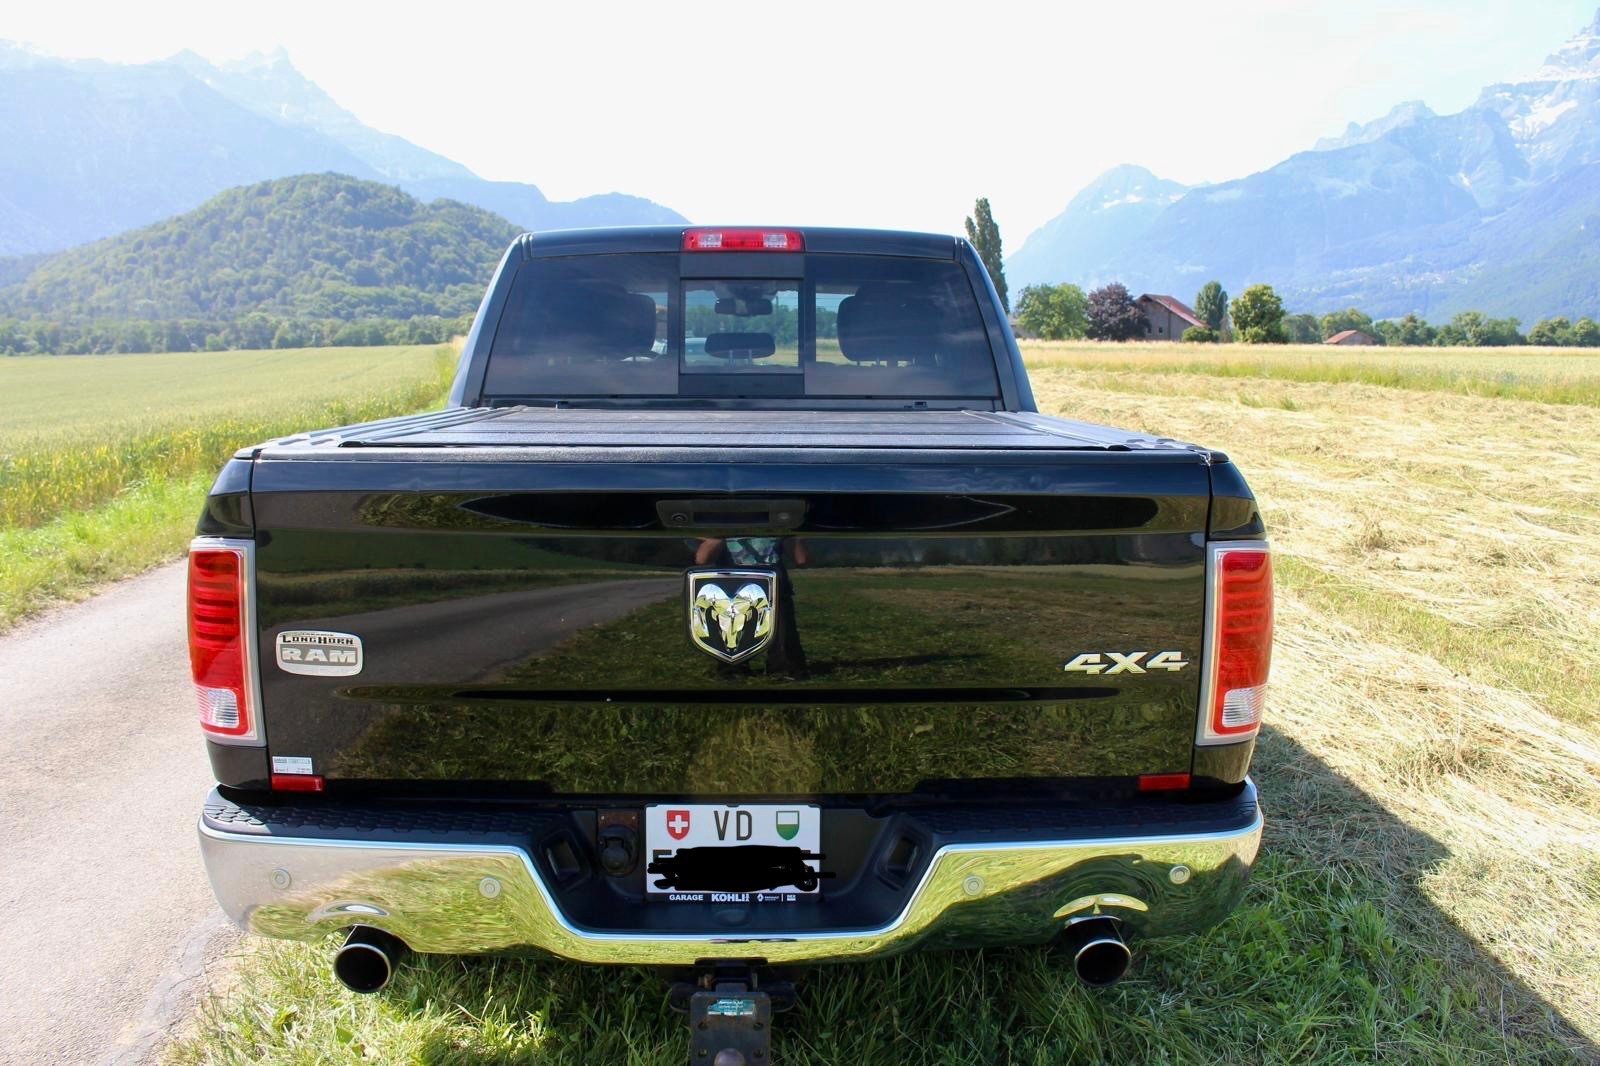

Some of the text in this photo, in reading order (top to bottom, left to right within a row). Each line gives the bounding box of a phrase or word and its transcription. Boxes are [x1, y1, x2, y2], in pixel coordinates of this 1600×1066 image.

[281, 647, 357, 663] RAM
[1064, 651, 1189, 675] 4X4
[713, 810, 753, 841] VD
